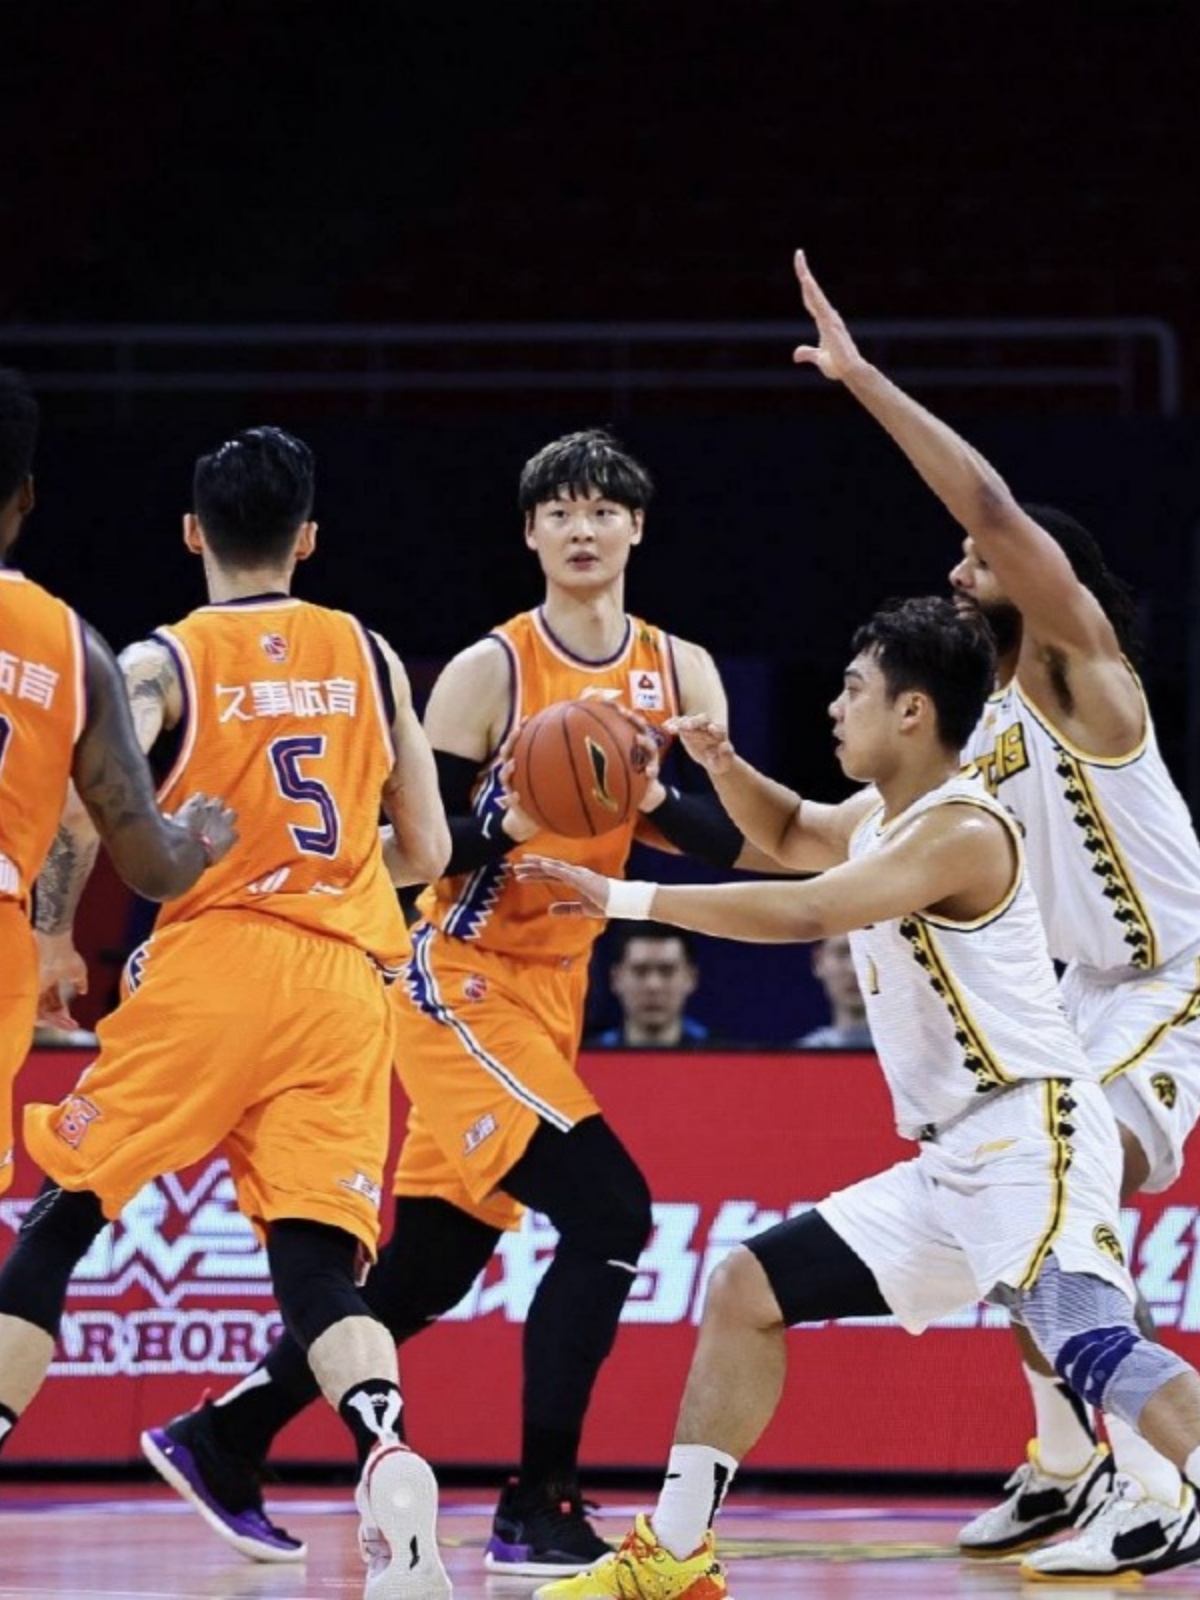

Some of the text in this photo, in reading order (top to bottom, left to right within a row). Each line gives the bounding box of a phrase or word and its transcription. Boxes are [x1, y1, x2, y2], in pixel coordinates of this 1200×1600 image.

[215, 677, 357, 722] 久事体育
[268, 735, 339, 860] 5
